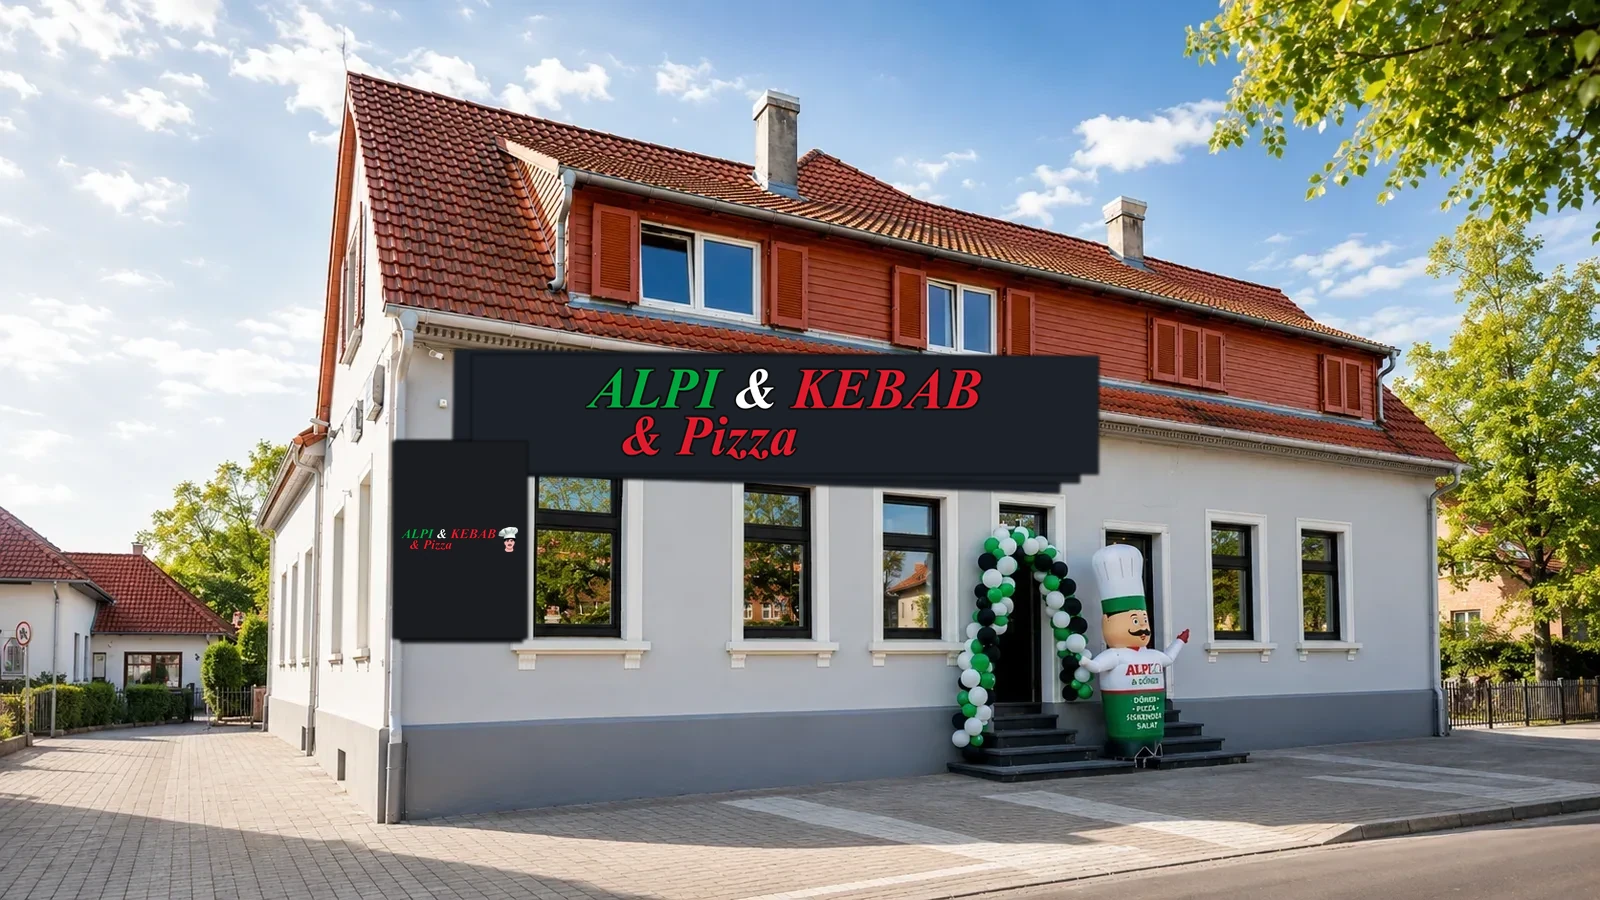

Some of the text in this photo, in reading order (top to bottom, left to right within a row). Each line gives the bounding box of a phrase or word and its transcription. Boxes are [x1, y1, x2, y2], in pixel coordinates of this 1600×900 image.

[586, 368, 982, 410] ALPI & KEBAB
[622, 416, 797, 460] & Pizza
[402, 529, 497, 539] ALPI & KEBAB
[410, 540, 452, 550] & Pizza
[1136, 722, 1158, 730] SALAT
